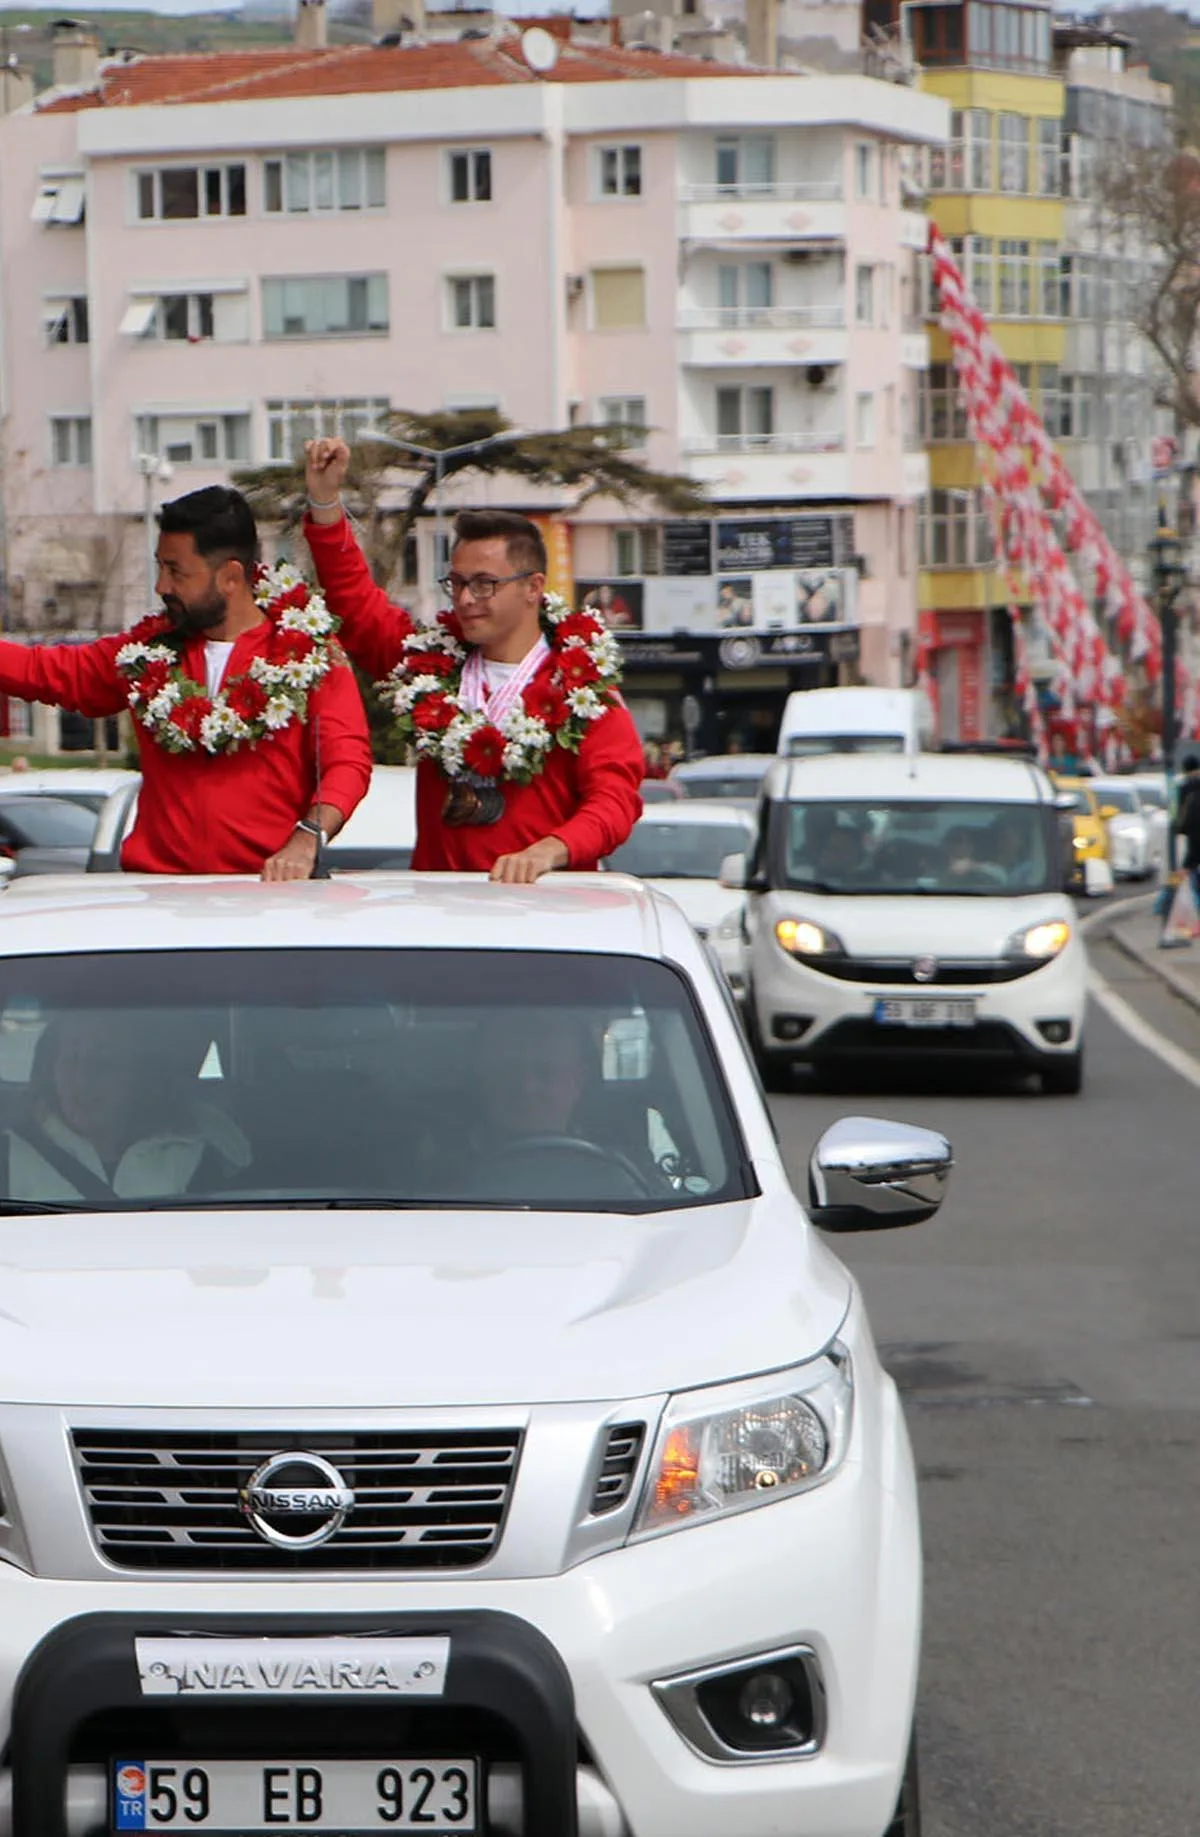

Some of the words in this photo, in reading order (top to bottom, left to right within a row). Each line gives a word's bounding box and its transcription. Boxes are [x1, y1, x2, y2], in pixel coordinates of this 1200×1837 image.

[250, 1494, 341, 1508] NISSAN
[182, 1657, 399, 1689] NAVARA
[149, 1767, 210, 1822] 59
[263, 1767, 323, 1822] EB
[376, 1767, 469, 1822] 923
[120, 1800, 144, 1816] TR
